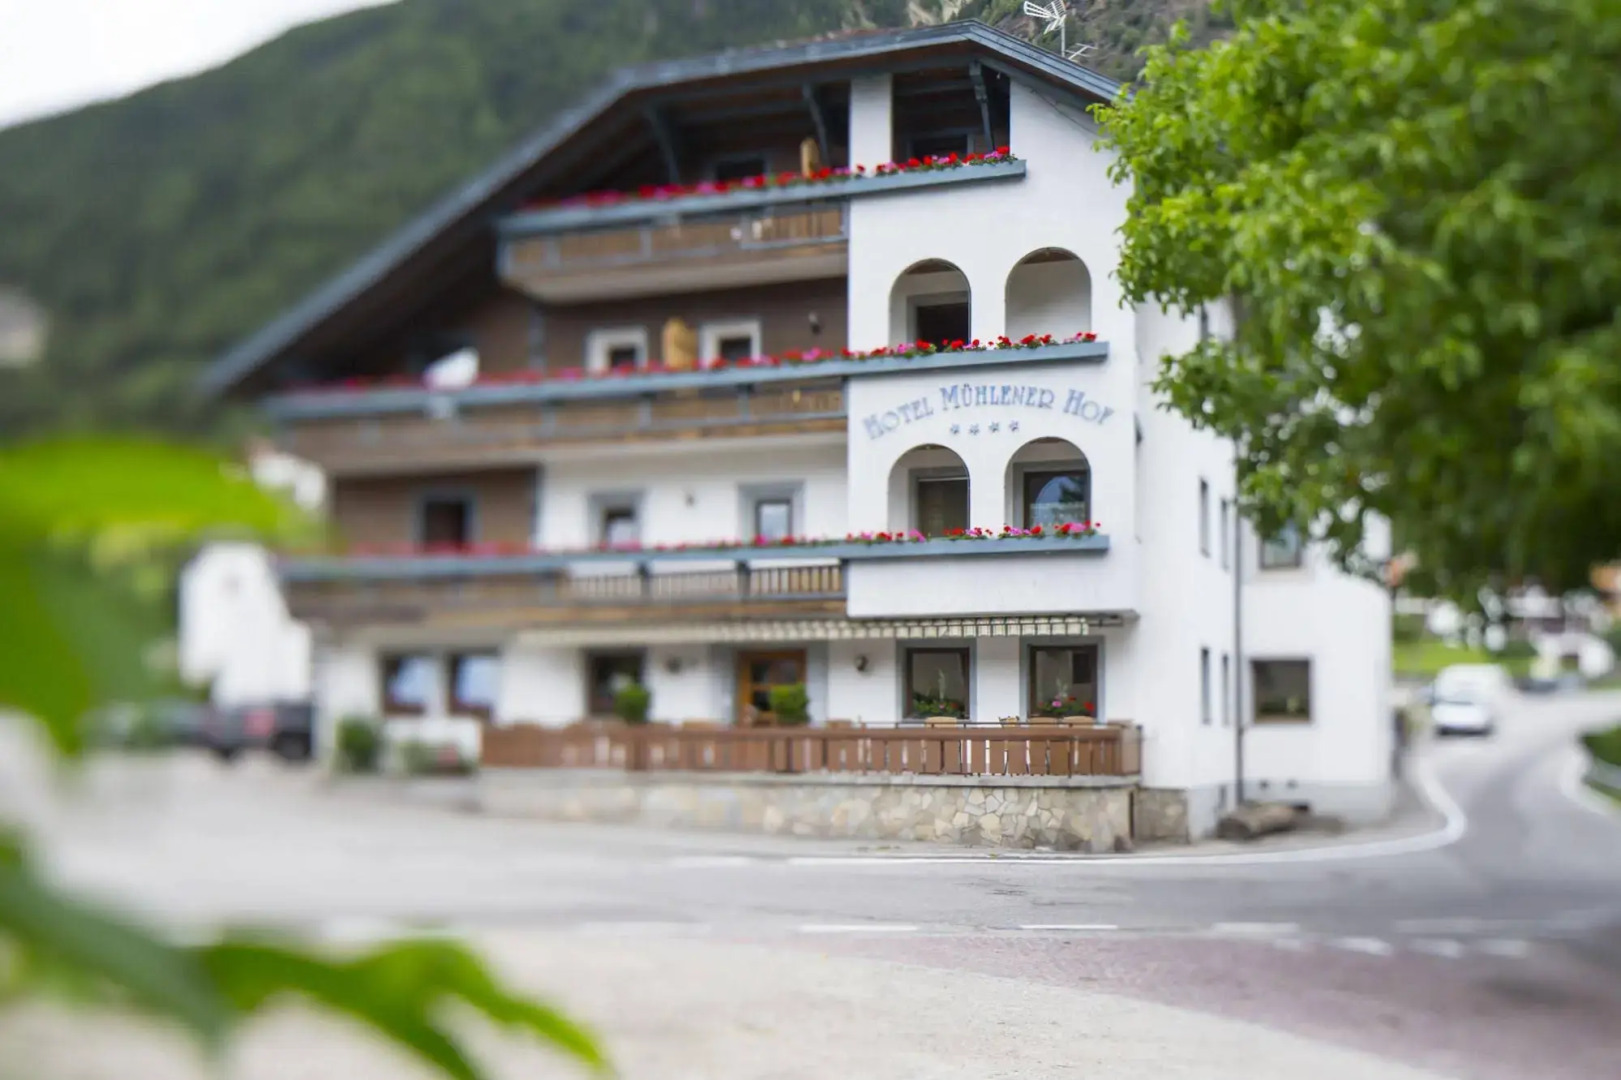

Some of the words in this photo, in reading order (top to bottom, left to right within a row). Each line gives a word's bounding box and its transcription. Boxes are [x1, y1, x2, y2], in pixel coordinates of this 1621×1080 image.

[863, 397, 934, 439] HOTEL
[939, 384, 1055, 411] MÜHLENER
[1062, 388, 1115, 425] HOF
